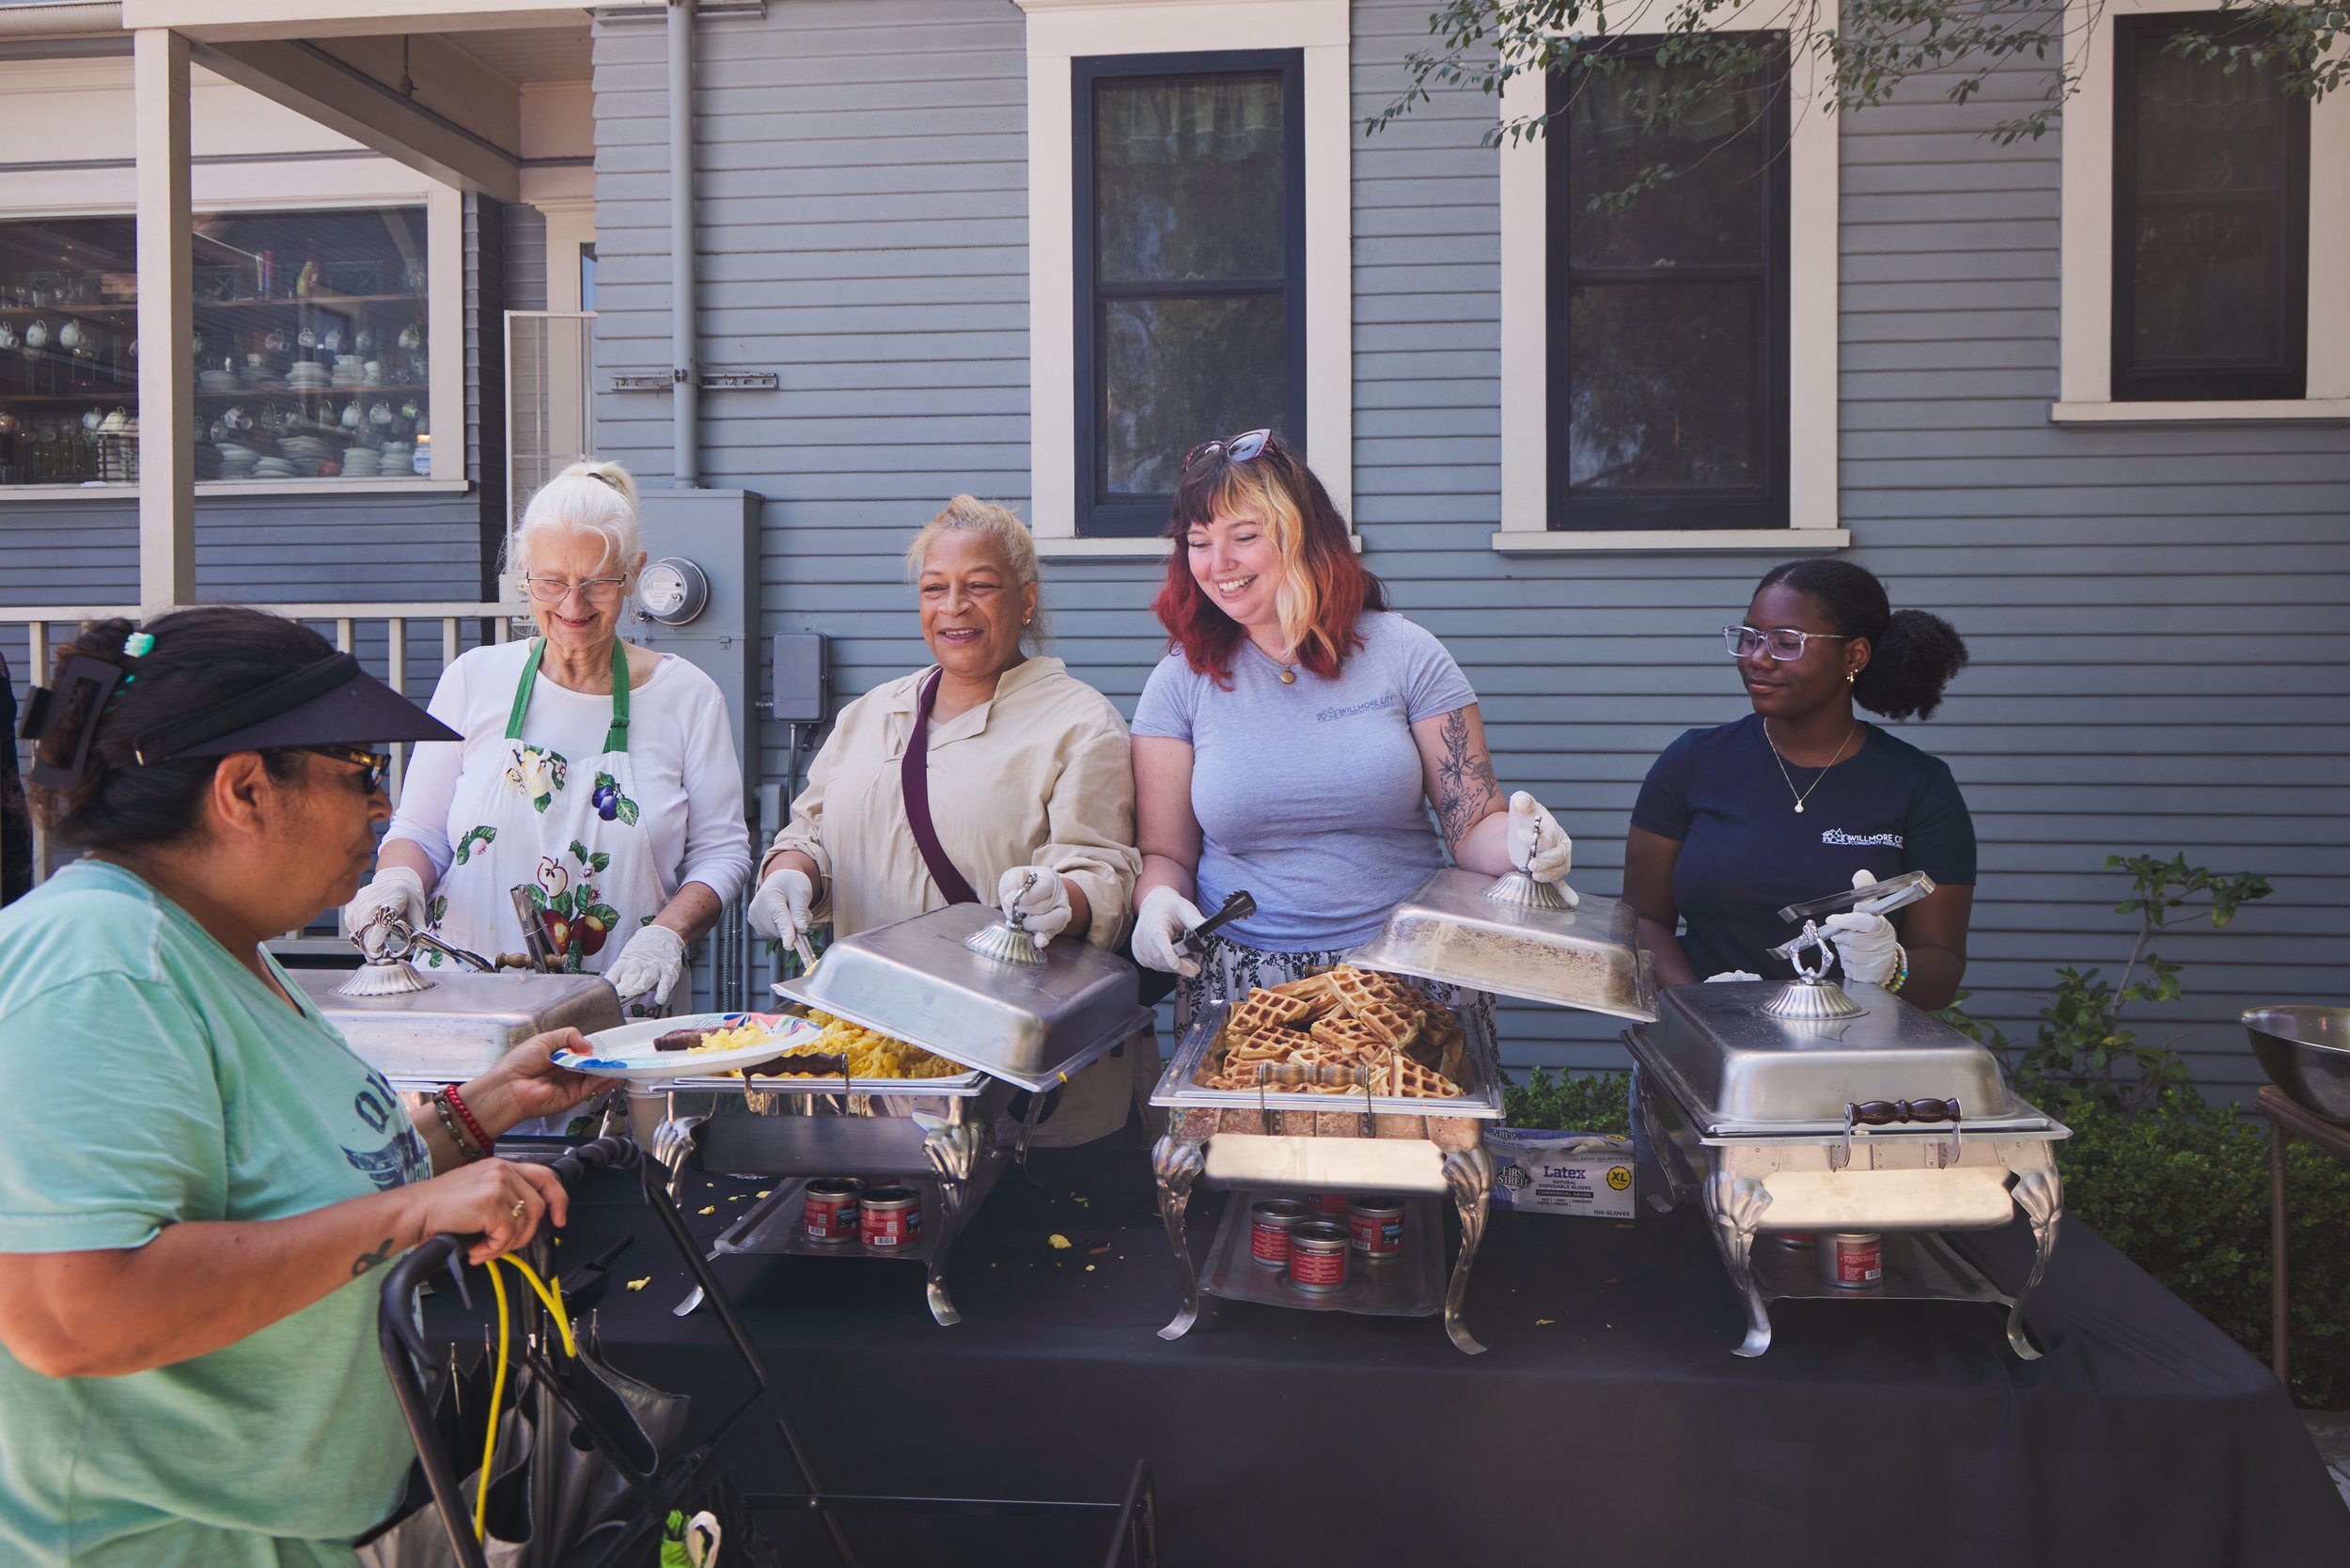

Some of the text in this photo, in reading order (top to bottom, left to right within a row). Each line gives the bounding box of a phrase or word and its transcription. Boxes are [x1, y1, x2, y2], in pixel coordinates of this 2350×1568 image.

[1340, 695, 1393, 714] WILLMORE CITY
[1849, 834, 1893, 842] WILLMORE
[1502, 1166, 1527, 1178] FIRST
[1543, 1166, 1587, 1180] Latex
[1611, 1171, 1628, 1183] XL
[1497, 1175, 1530, 1187] STREET
